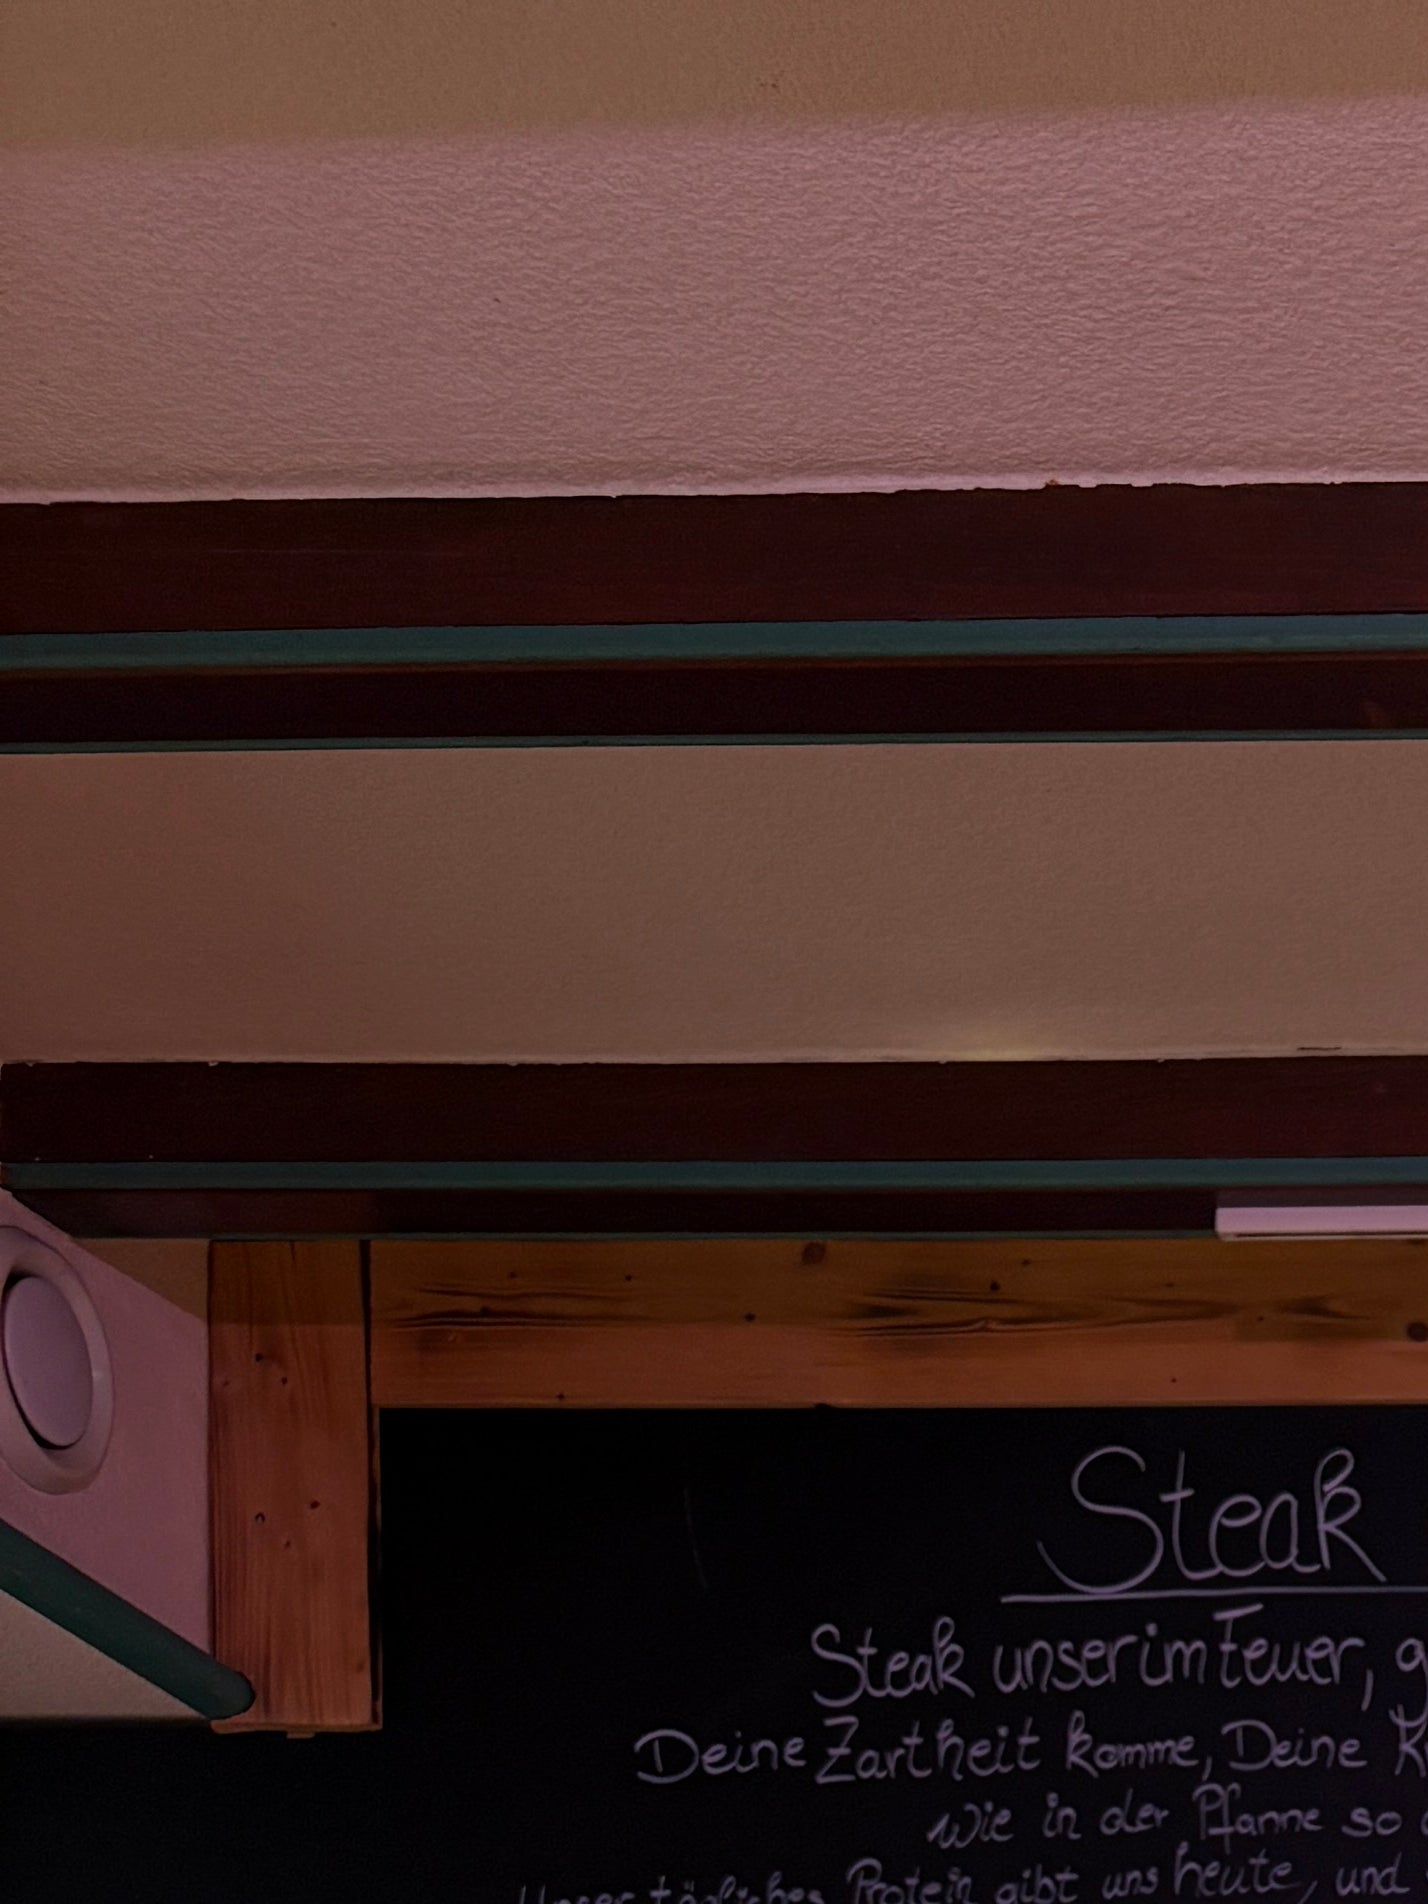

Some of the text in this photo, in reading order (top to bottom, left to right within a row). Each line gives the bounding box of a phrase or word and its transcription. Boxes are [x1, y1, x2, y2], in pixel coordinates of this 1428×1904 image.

[1036, 1446, 1386, 1595] Steak
[811, 1616, 976, 1708] Steak
[633, 1728, 807, 1785] Deine
[812, 1715, 1042, 1785] Zartheit
[1063, 1709, 1214, 1778] komme,
[1220, 1717, 1369, 1773] Deine
[1041, 1791, 1083, 1840] in
[1101, 1788, 1170, 1836] der
[1191, 1782, 1323, 1855] Pfanne
[1341, 1806, 1402, 1837] so
[1101, 1862, 1160, 1900] uns
[1334, 1853, 1411, 1897] und
